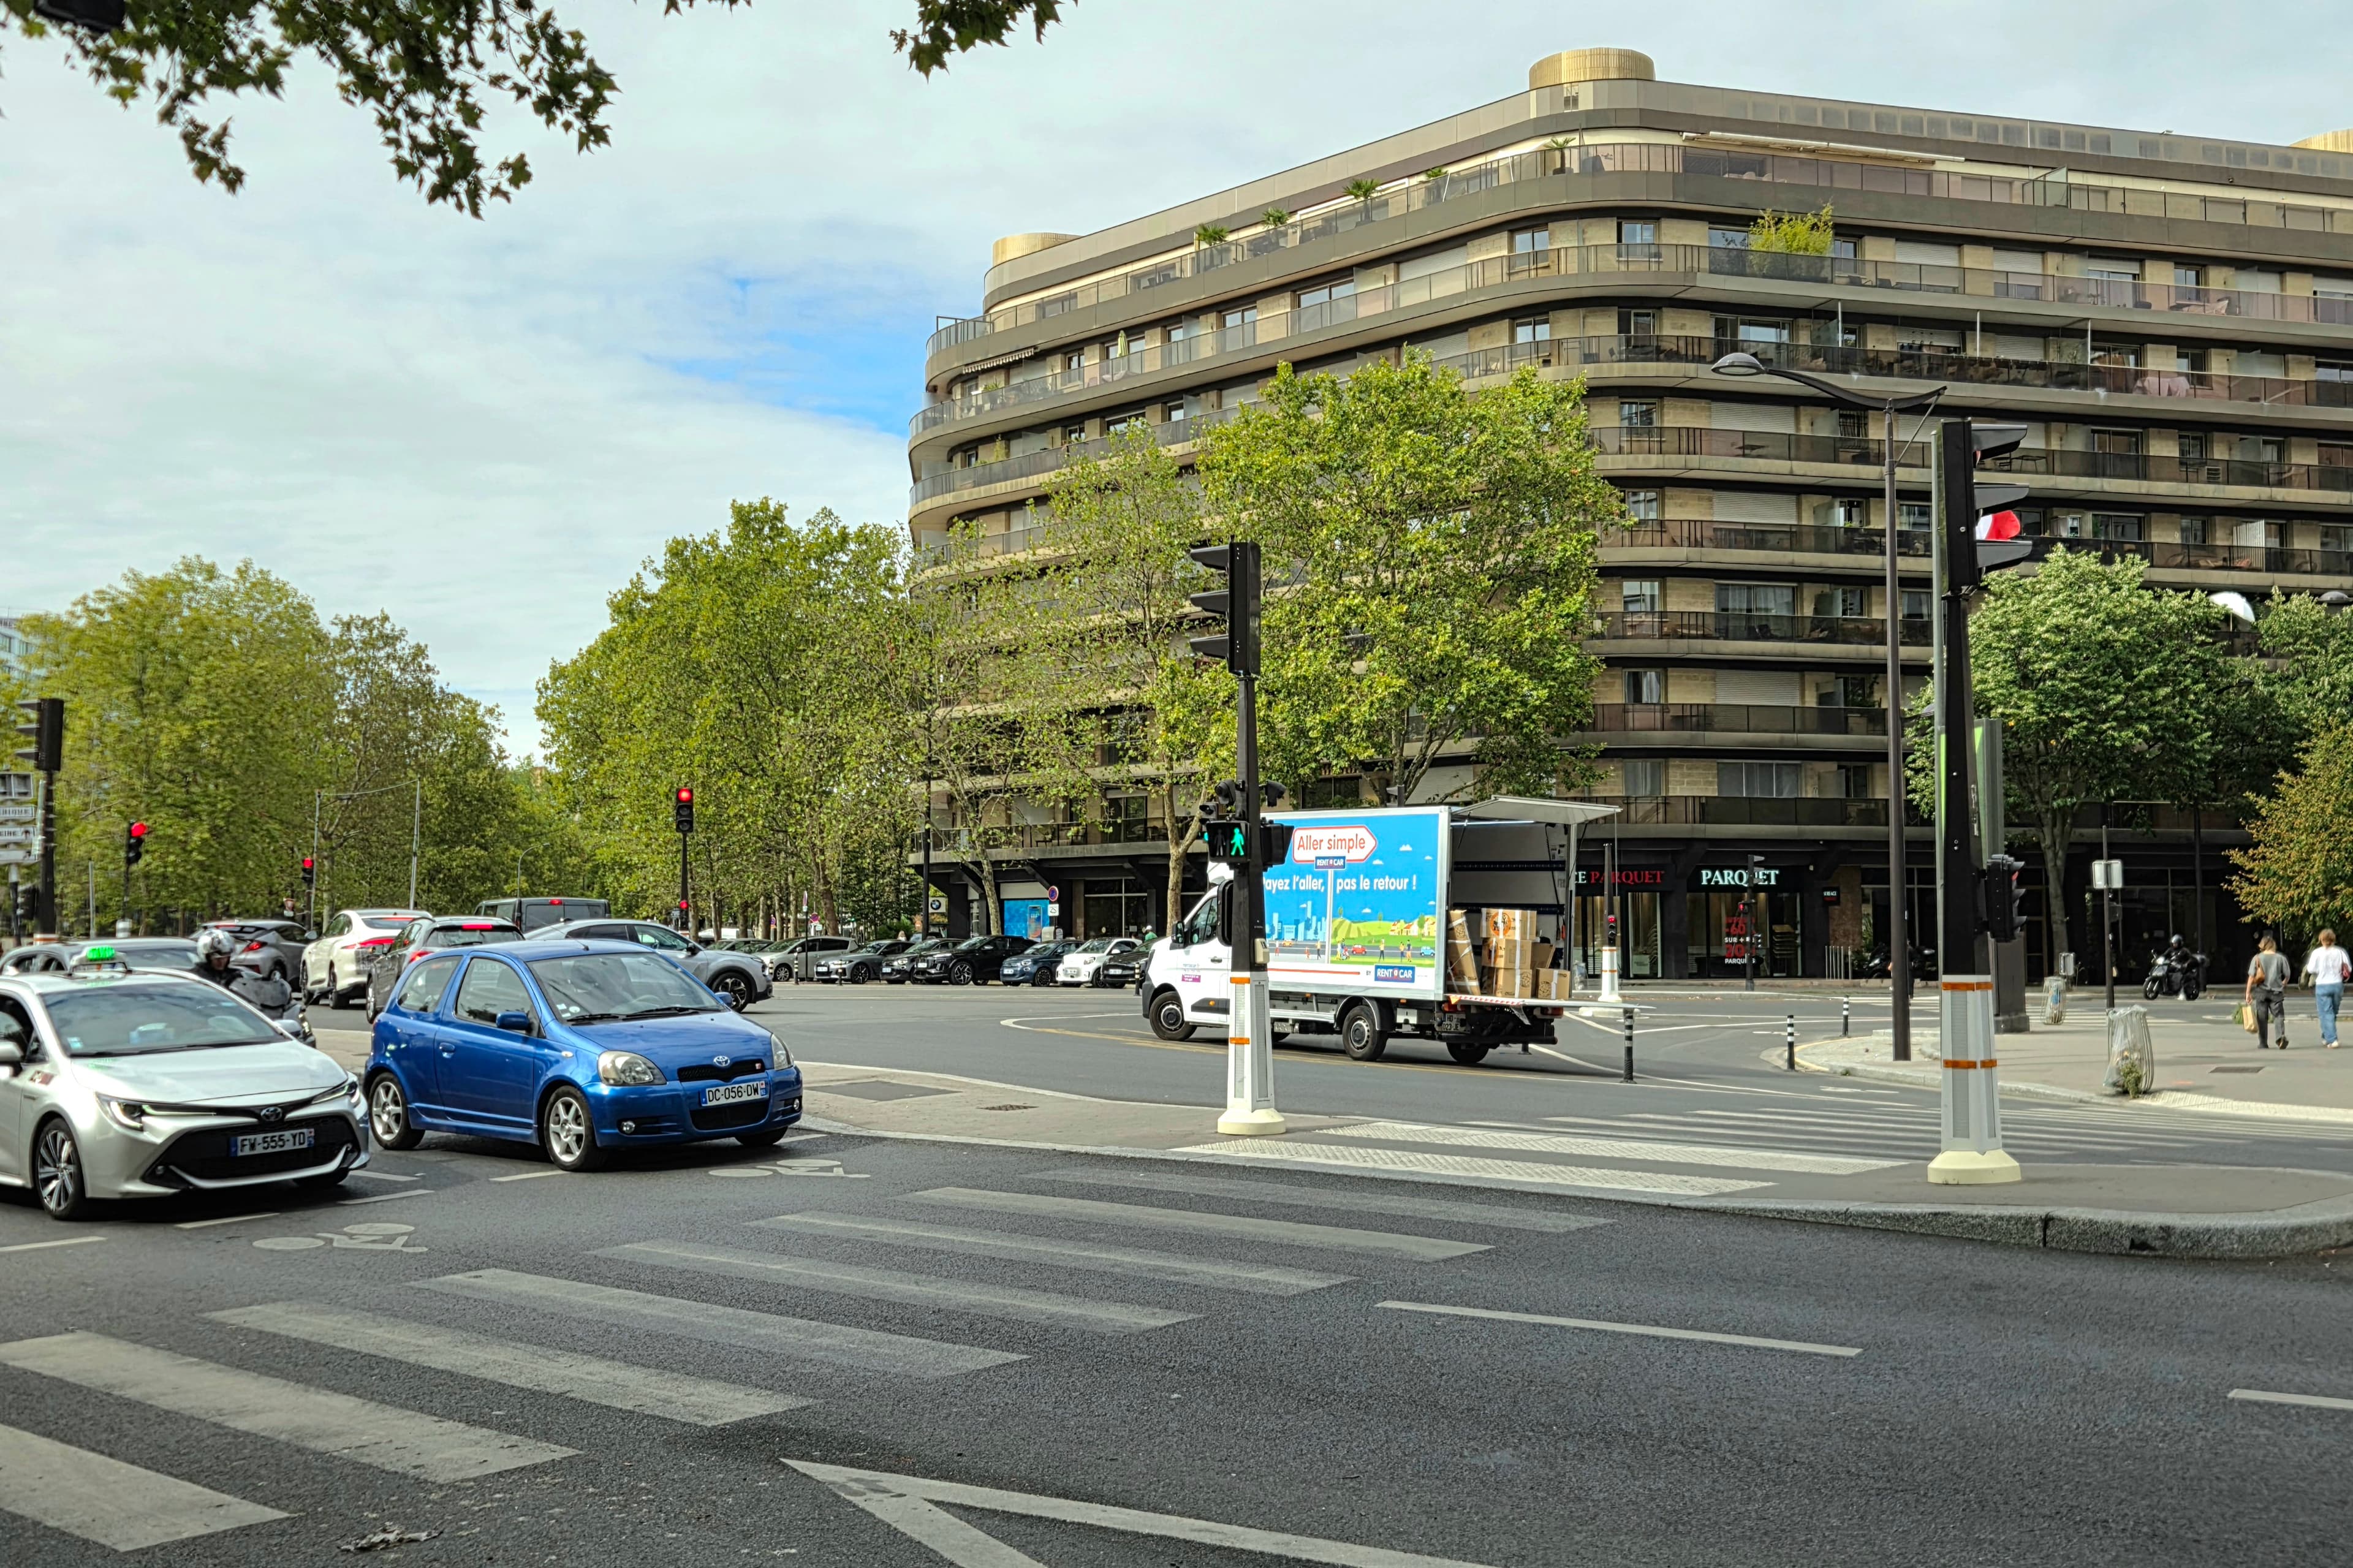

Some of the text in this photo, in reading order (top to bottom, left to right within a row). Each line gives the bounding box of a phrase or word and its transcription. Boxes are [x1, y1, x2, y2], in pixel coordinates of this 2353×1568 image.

[1297, 833, 1366, 854] Aller simple
[1293, 874, 1325, 893] l'aller,
[1336, 878, 1357, 894] pas
[1360, 874, 1370, 890] le
[1373, 876, 1409, 890] retour
[1412, 874, 1417, 890] !
[1575, 871, 1586, 884] E
[1377, 968, 1393, 978] RENT
[1399, 969, 1412, 979] CAR
[708, 1083, 759, 1102] DC-056-DW
[240, 1132, 306, 1153] FW-555-YD
